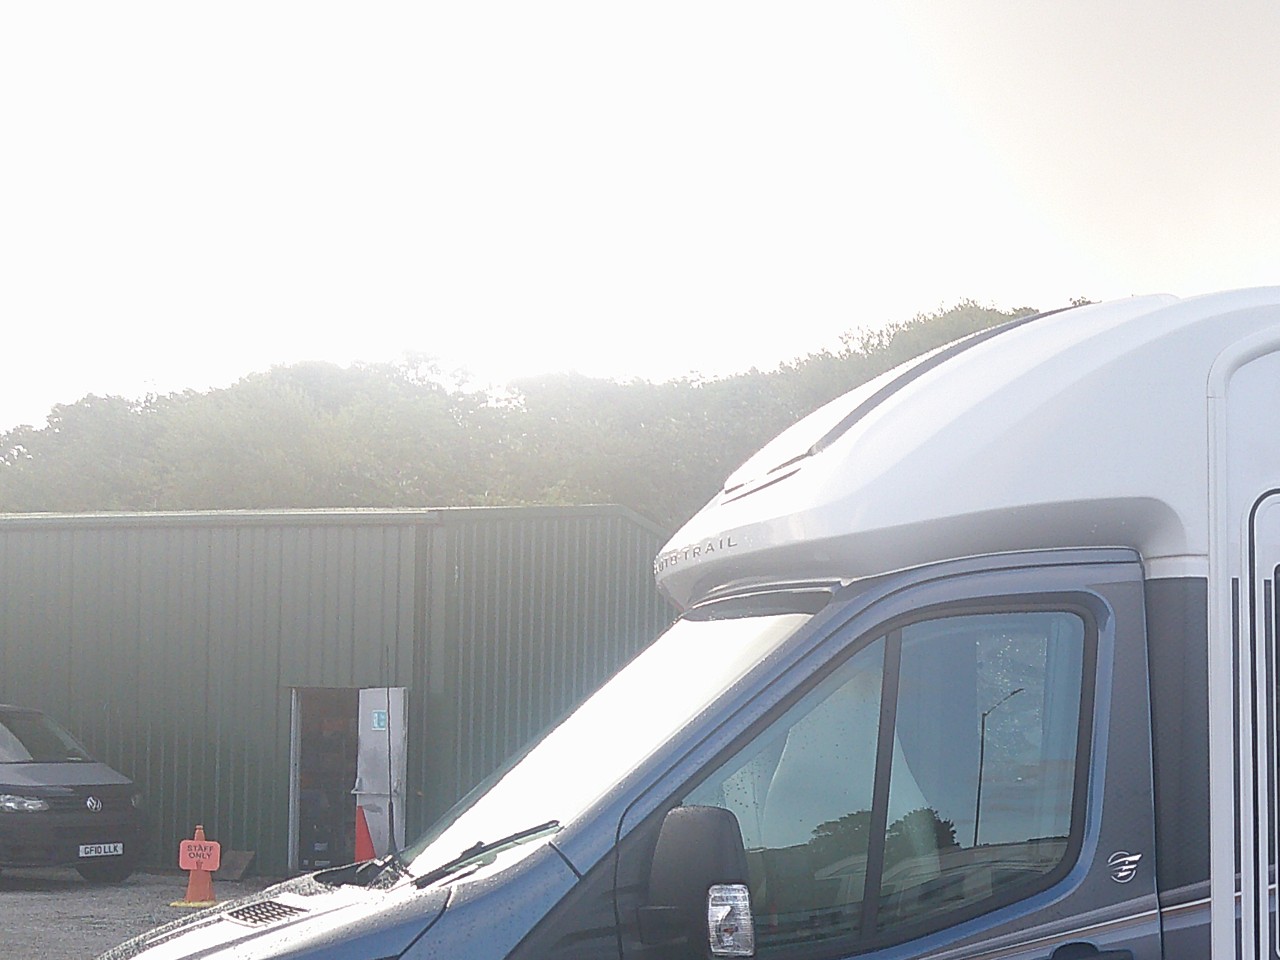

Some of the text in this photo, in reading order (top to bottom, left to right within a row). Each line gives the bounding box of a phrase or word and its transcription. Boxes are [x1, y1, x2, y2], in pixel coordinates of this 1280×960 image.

[103, 843, 119, 854] LLK
[187, 844, 214, 853] STAFF
[188, 851, 213, 860] ONLY
